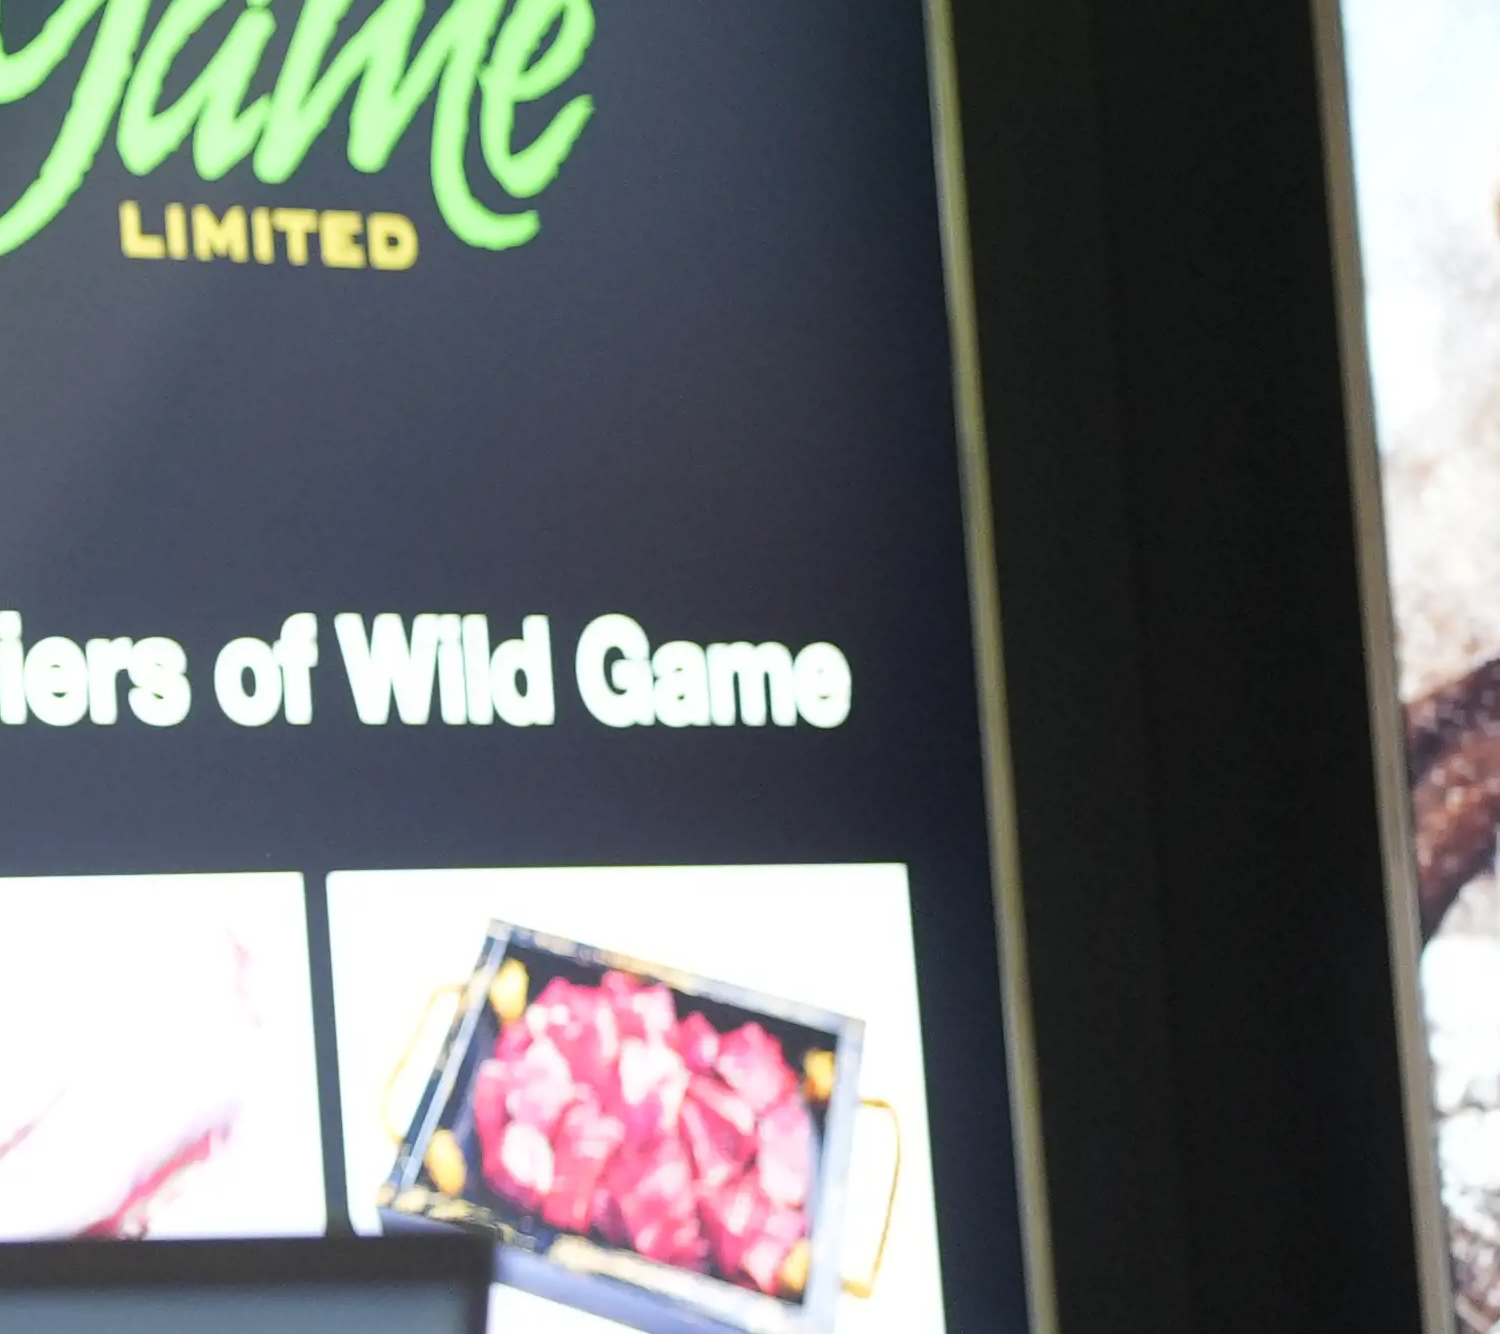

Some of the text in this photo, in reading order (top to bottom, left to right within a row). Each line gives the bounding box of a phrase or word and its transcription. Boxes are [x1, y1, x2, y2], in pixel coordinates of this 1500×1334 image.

[120, 201, 418, 270] LIMITED
[213, 612, 319, 727] of
[333, 612, 556, 727] Wild
[575, 613, 852, 729] Game
